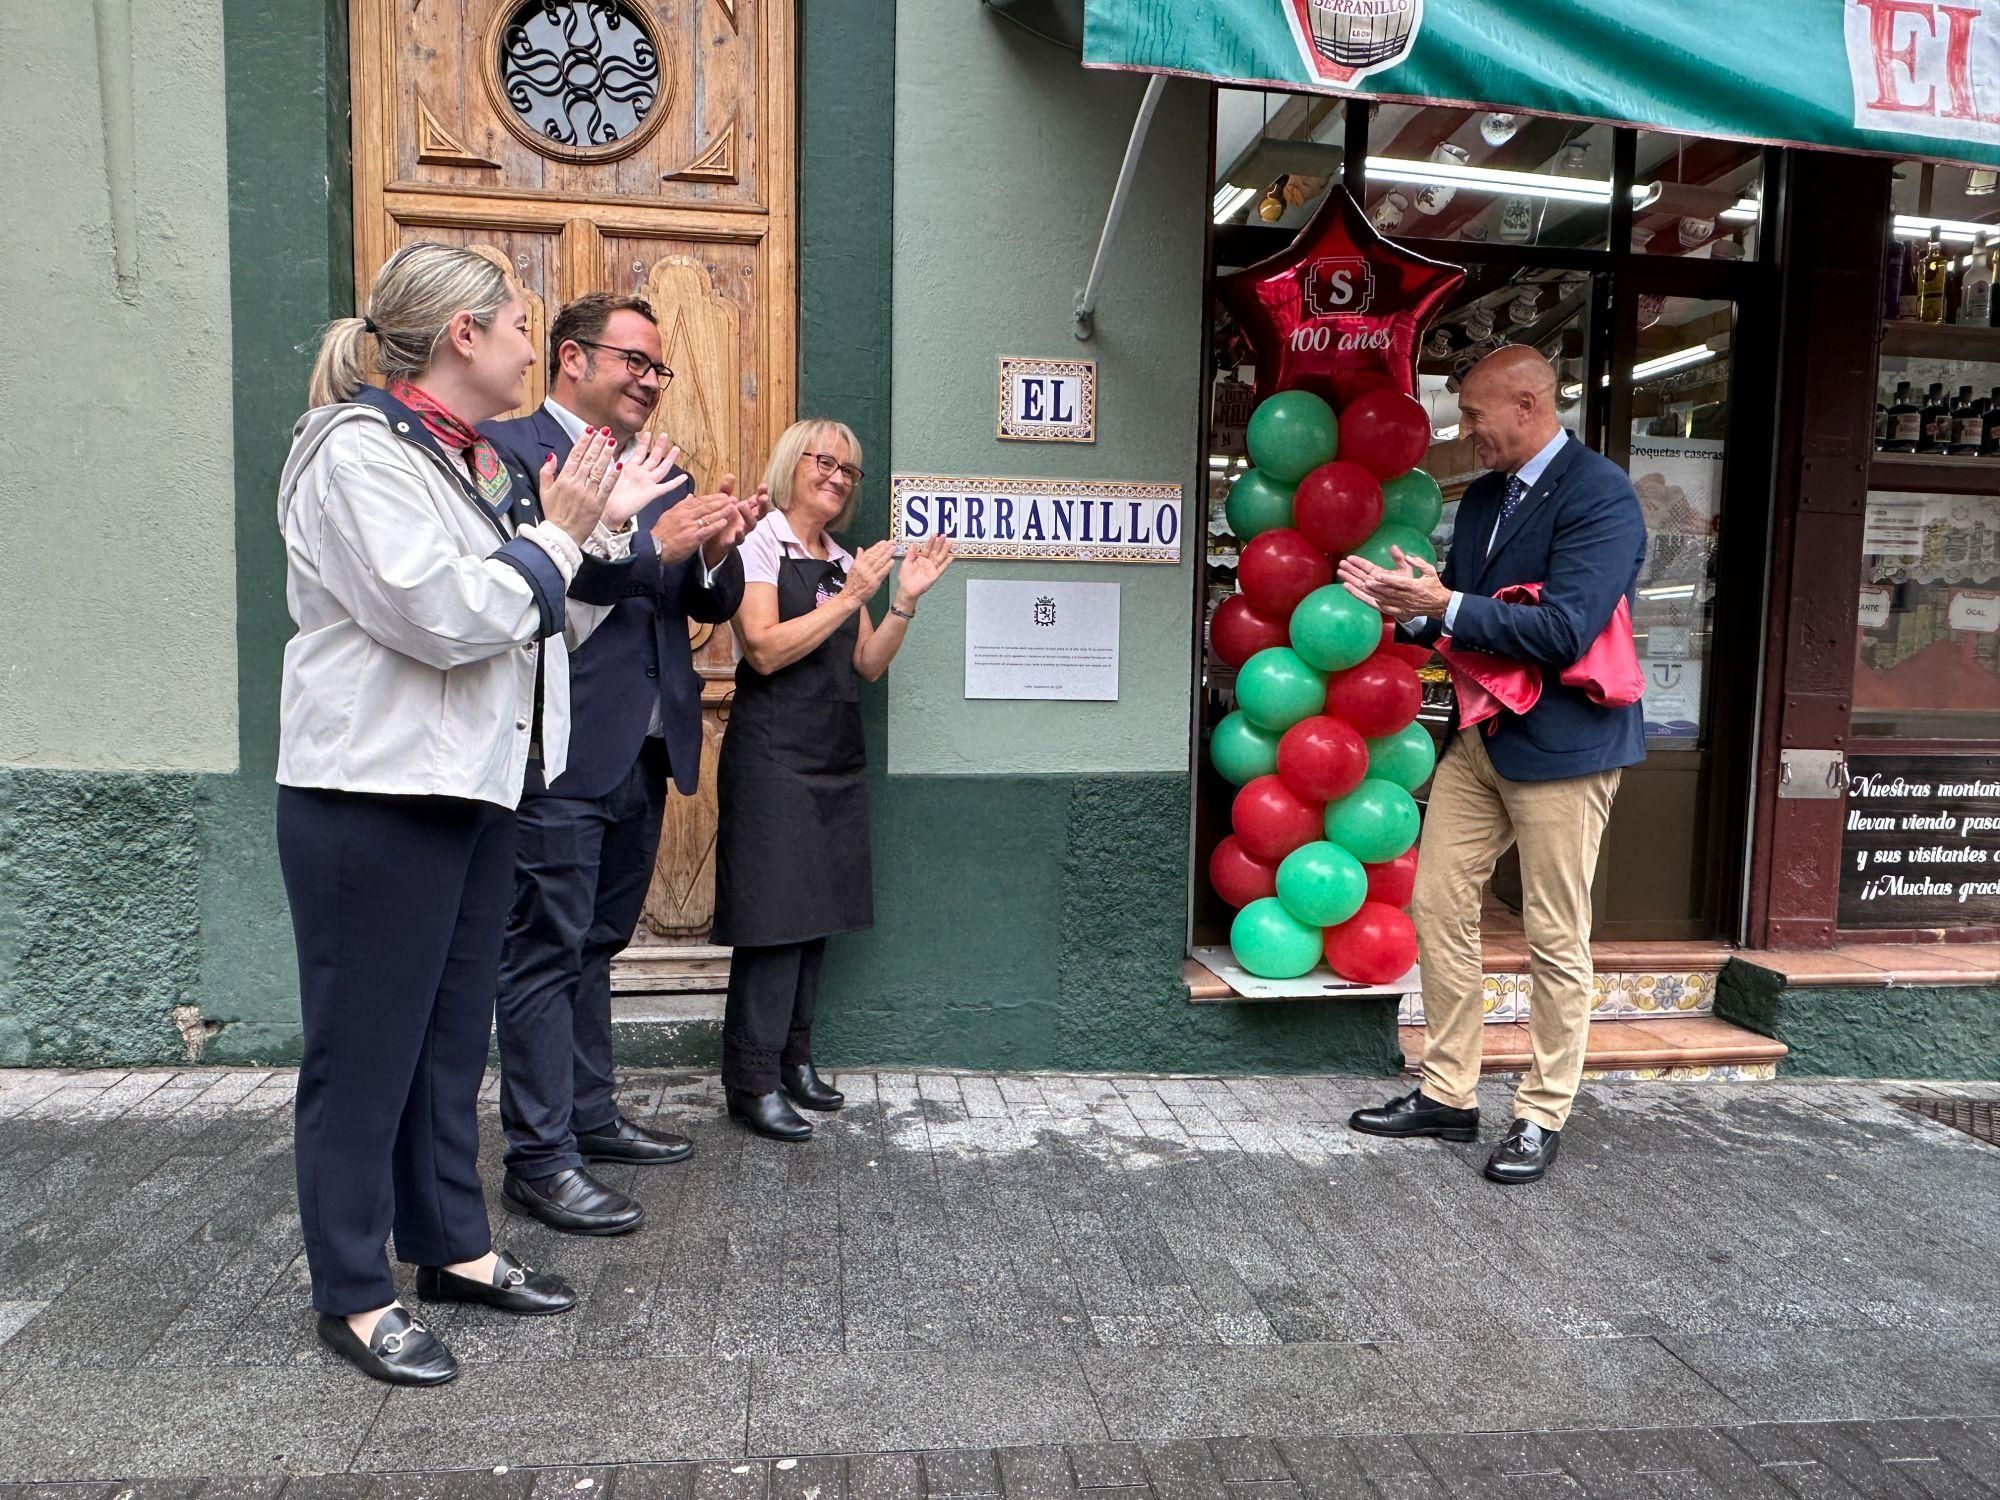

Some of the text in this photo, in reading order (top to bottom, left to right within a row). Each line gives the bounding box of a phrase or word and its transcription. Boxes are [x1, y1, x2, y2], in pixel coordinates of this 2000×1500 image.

[1330, 269, 1354, 305] S
[1289, 326, 1394, 352] 100 años
[1020, 378, 1073, 422] EL
[1629, 445, 1725, 460] Croquetas caseras
[905, 495, 1178, 545] SERRANILLO
[1850, 773, 1931, 797] Nuestras
[1847, 810, 1896, 830] llevan
[1902, 810, 1957, 830] viendo
[1857, 851, 1868, 871] y
[1873, 850, 1902, 863] sus
[1908, 845, 1987, 863] visitantes
